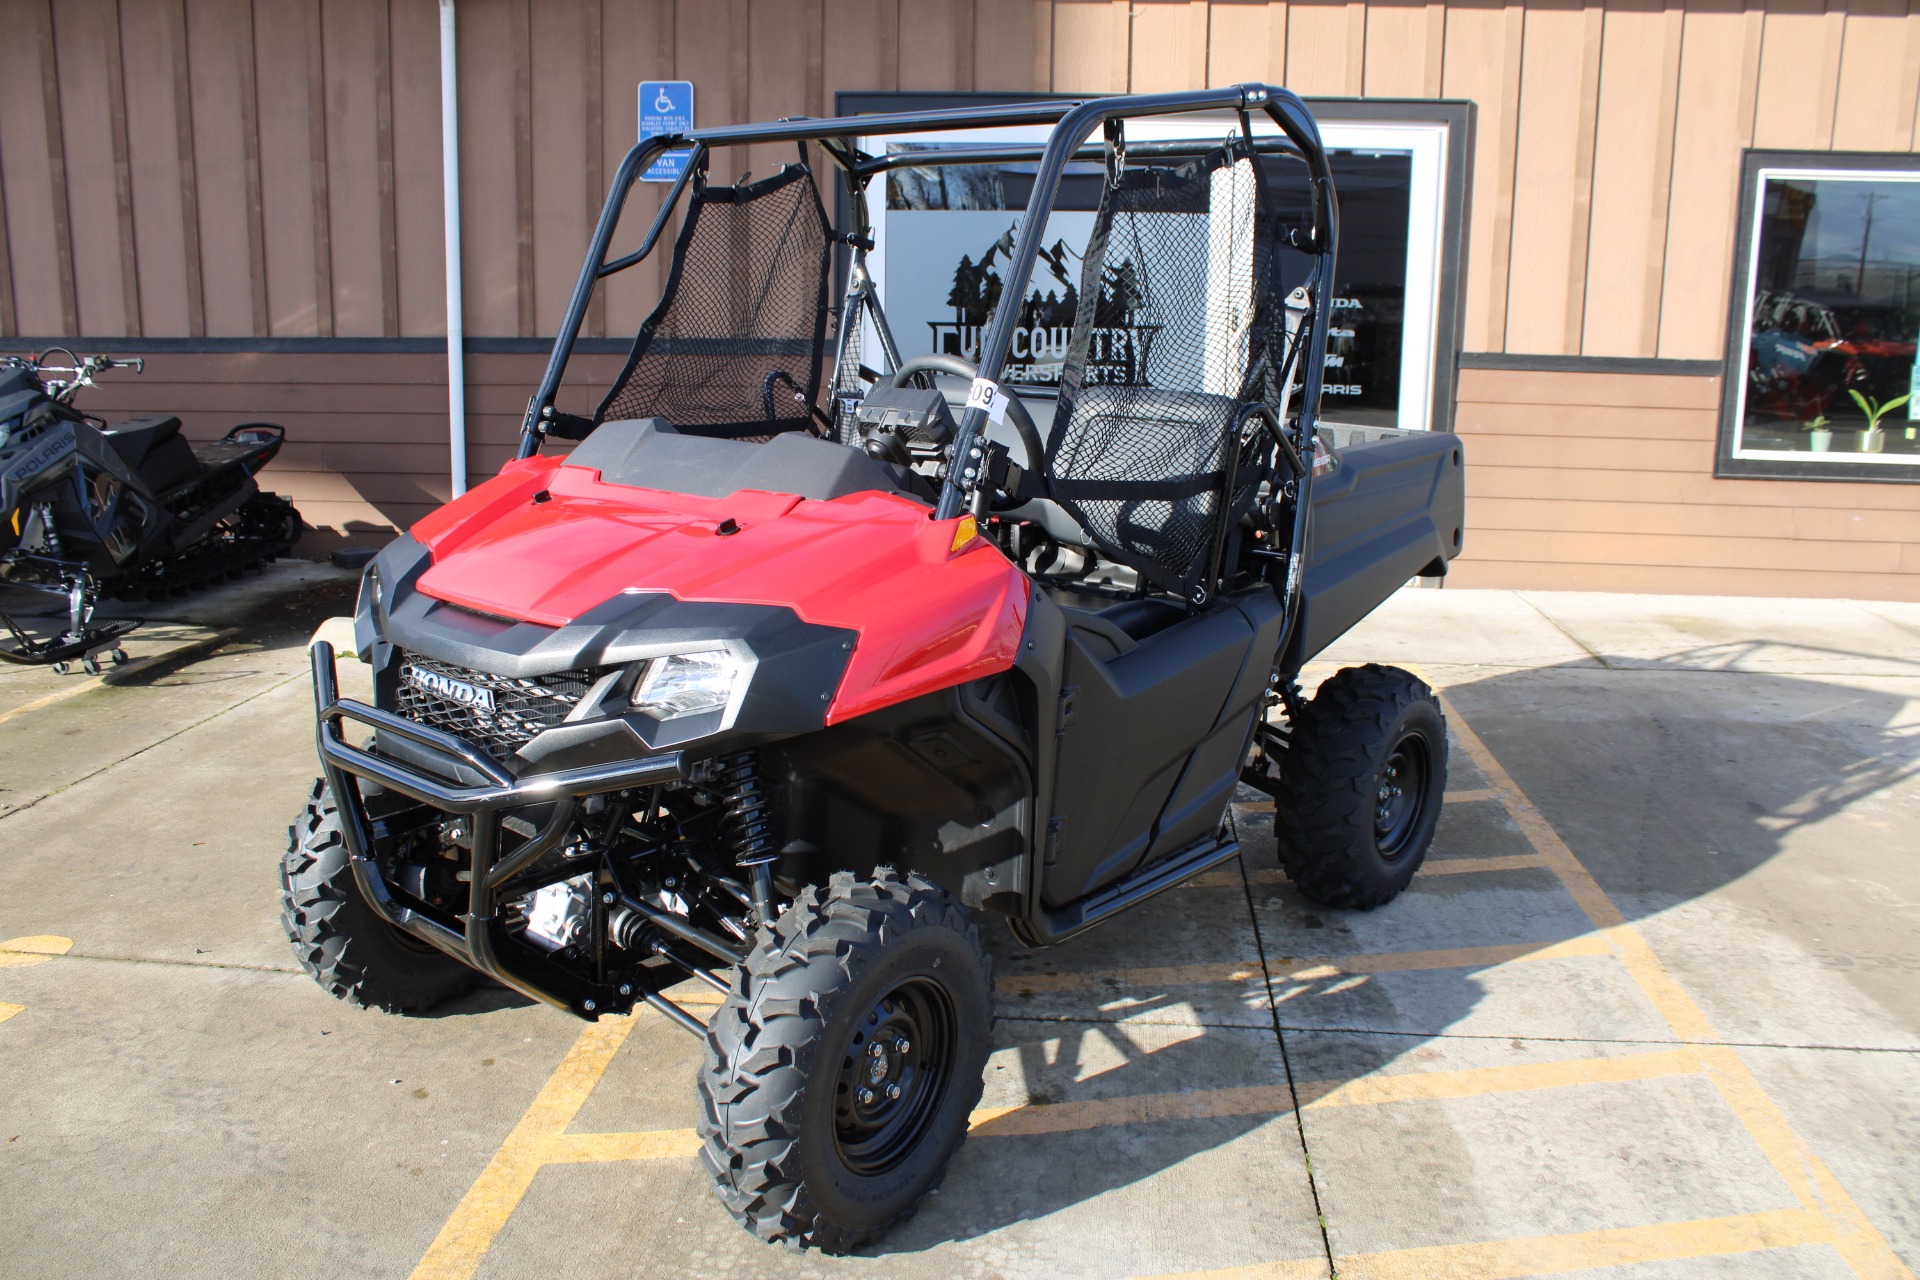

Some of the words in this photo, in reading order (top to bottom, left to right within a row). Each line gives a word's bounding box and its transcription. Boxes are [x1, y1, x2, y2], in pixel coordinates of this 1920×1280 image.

[656, 158, 675, 167] VAN
[1330, 298, 1363, 309] DA
[1012, 326, 1157, 383] COUTRY
[1324, 354, 1345, 368] TM
[972, 384, 997, 408] 09
[15, 431, 77, 479] POLARIS
[1313, 454, 1331, 468] EER
[410, 665, 496, 713] HONDA
